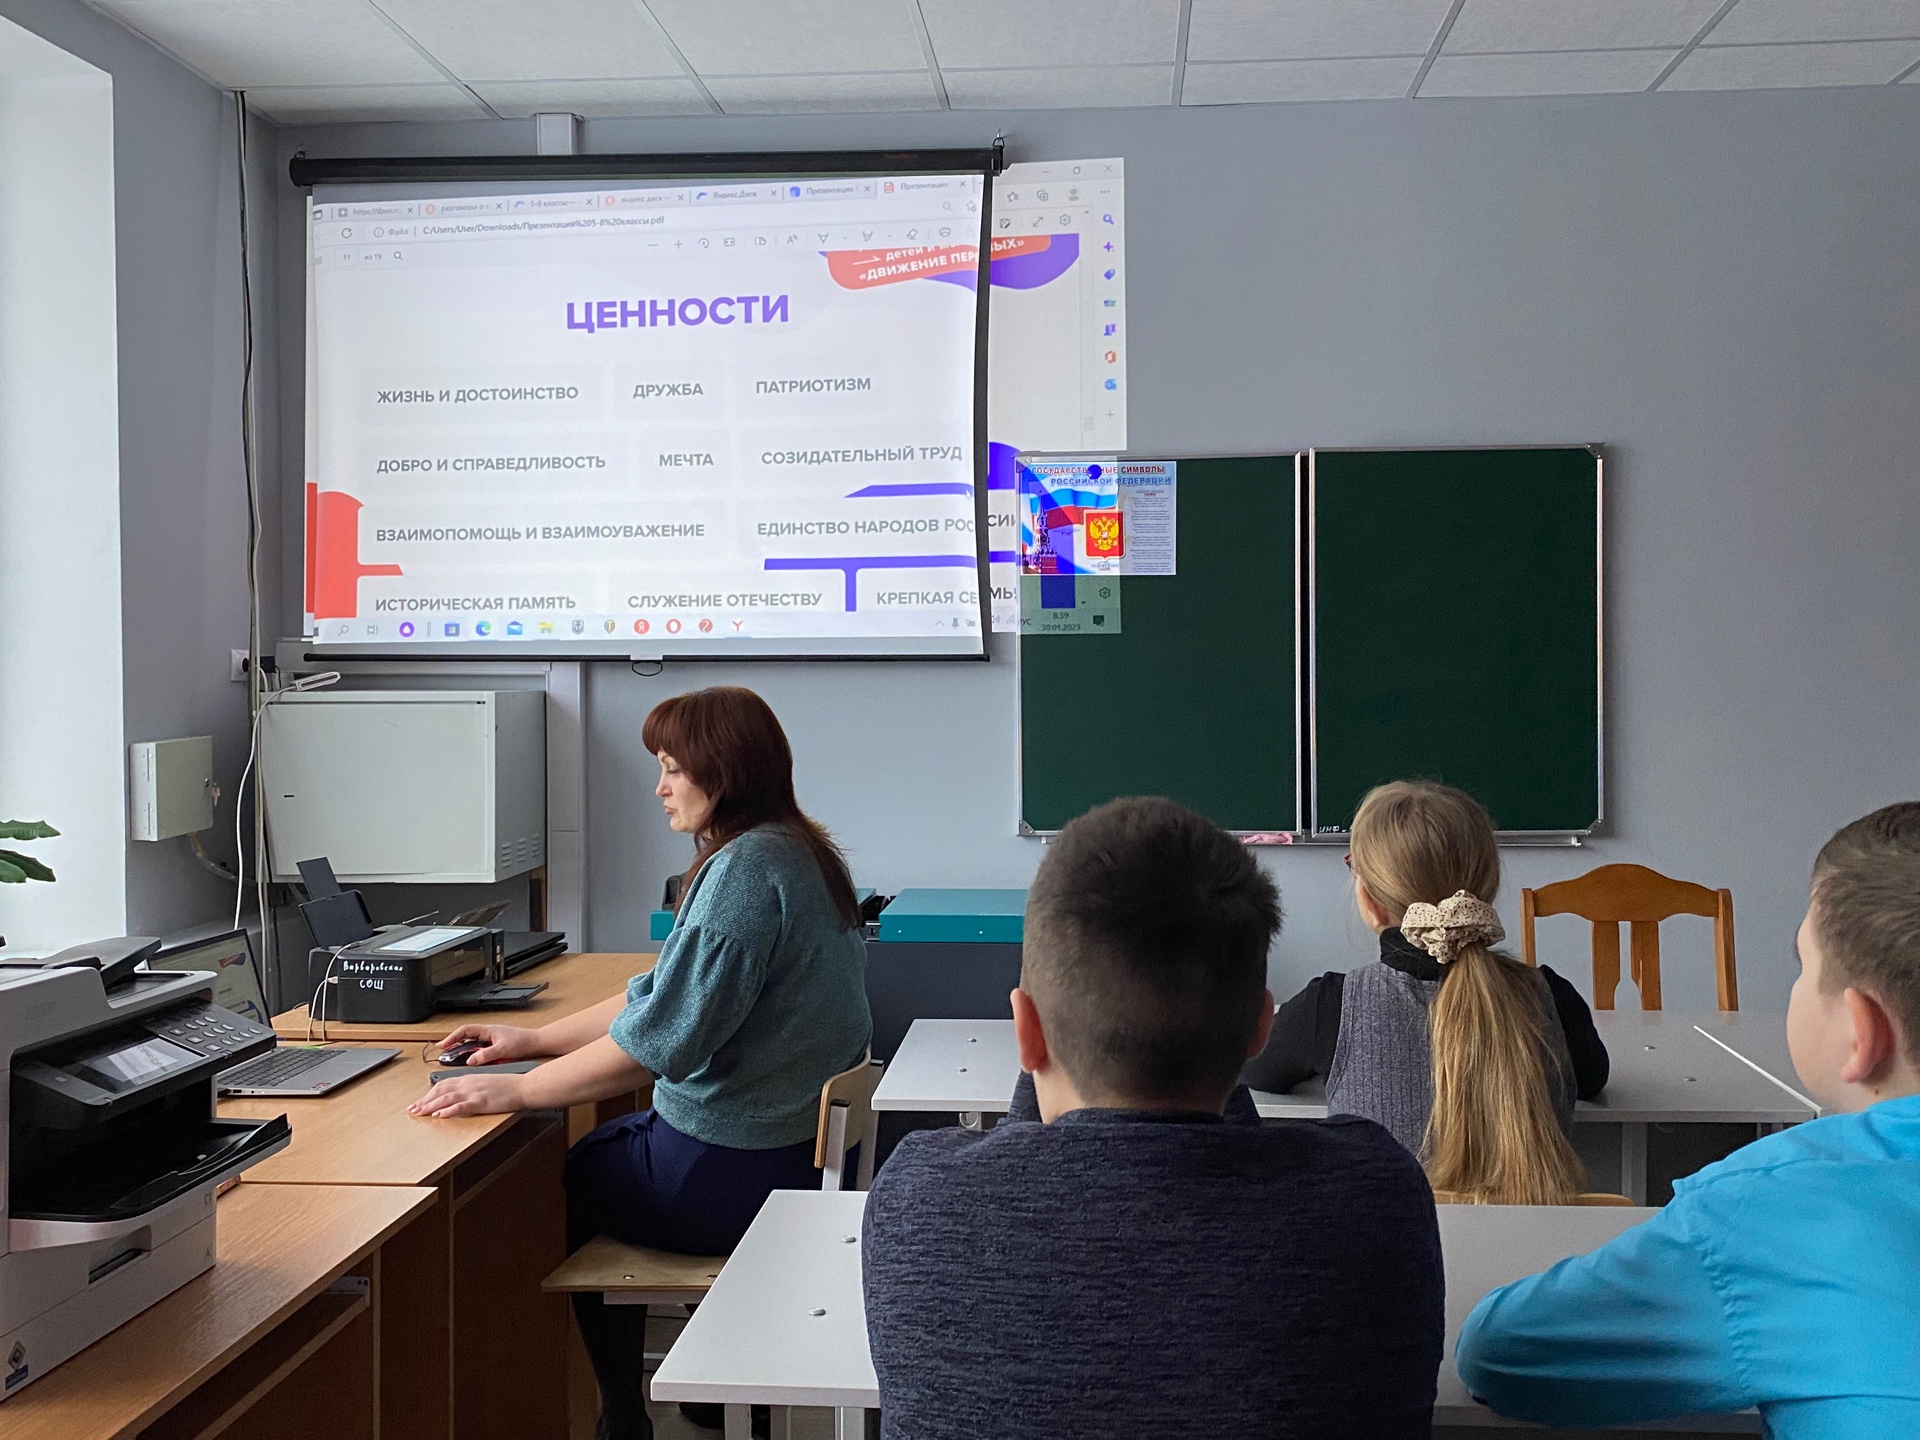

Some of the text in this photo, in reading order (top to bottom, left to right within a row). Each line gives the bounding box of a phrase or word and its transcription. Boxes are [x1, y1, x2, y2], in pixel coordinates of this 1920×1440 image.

[806, 185, 854, 195] Презентация
[900, 181, 948, 191] Презентация
[388, 228, 408, 236] Файл
[859, 255, 948, 281] «ДВИЖЕНИЕ
[567, 294, 789, 334] ЦЕННОСТИ
[633, 383, 704, 399] ДРУЖБА
[756, 377, 872, 395] ПАТРИОТИЗМ
[377, 386, 579, 404] ЖИЗНЬ И ДОСТОИНСТВО
[659, 453, 714, 467] МЕЧТА
[761, 446, 963, 465] СОЗИДАТЕЛЬНЫЙ ТРУД
[376, 455, 606, 474] ДОБРО И СПРАВЕДЛИВОСТЬ
[1121, 465, 1165, 473] СИМВОЛЫ
[1115, 475, 1171, 487] ФЕДЕРАЦИИ
[376, 524, 705, 543] ВЗАИМОПОМОЩЬ И ВЗАИМОУВАЖЕНИЕ
[757, 520, 850, 537] ЕДИНСТВО
[854, 518, 940, 535] НАРОДОВ
[375, 596, 577, 613] ИСТОРИЧЕСКАЯ ПАМЯТЬ
[628, 591, 823, 609] СЛУЖЕНИЕ ОТЕЧЕСТВУ
[877, 590, 954, 606] КРЕПКАЯ
[1052, 611, 1069, 620] 8:39
[1041, 623, 1081, 632] 30.01.2023
[359, 979, 384, 991] СОШ
